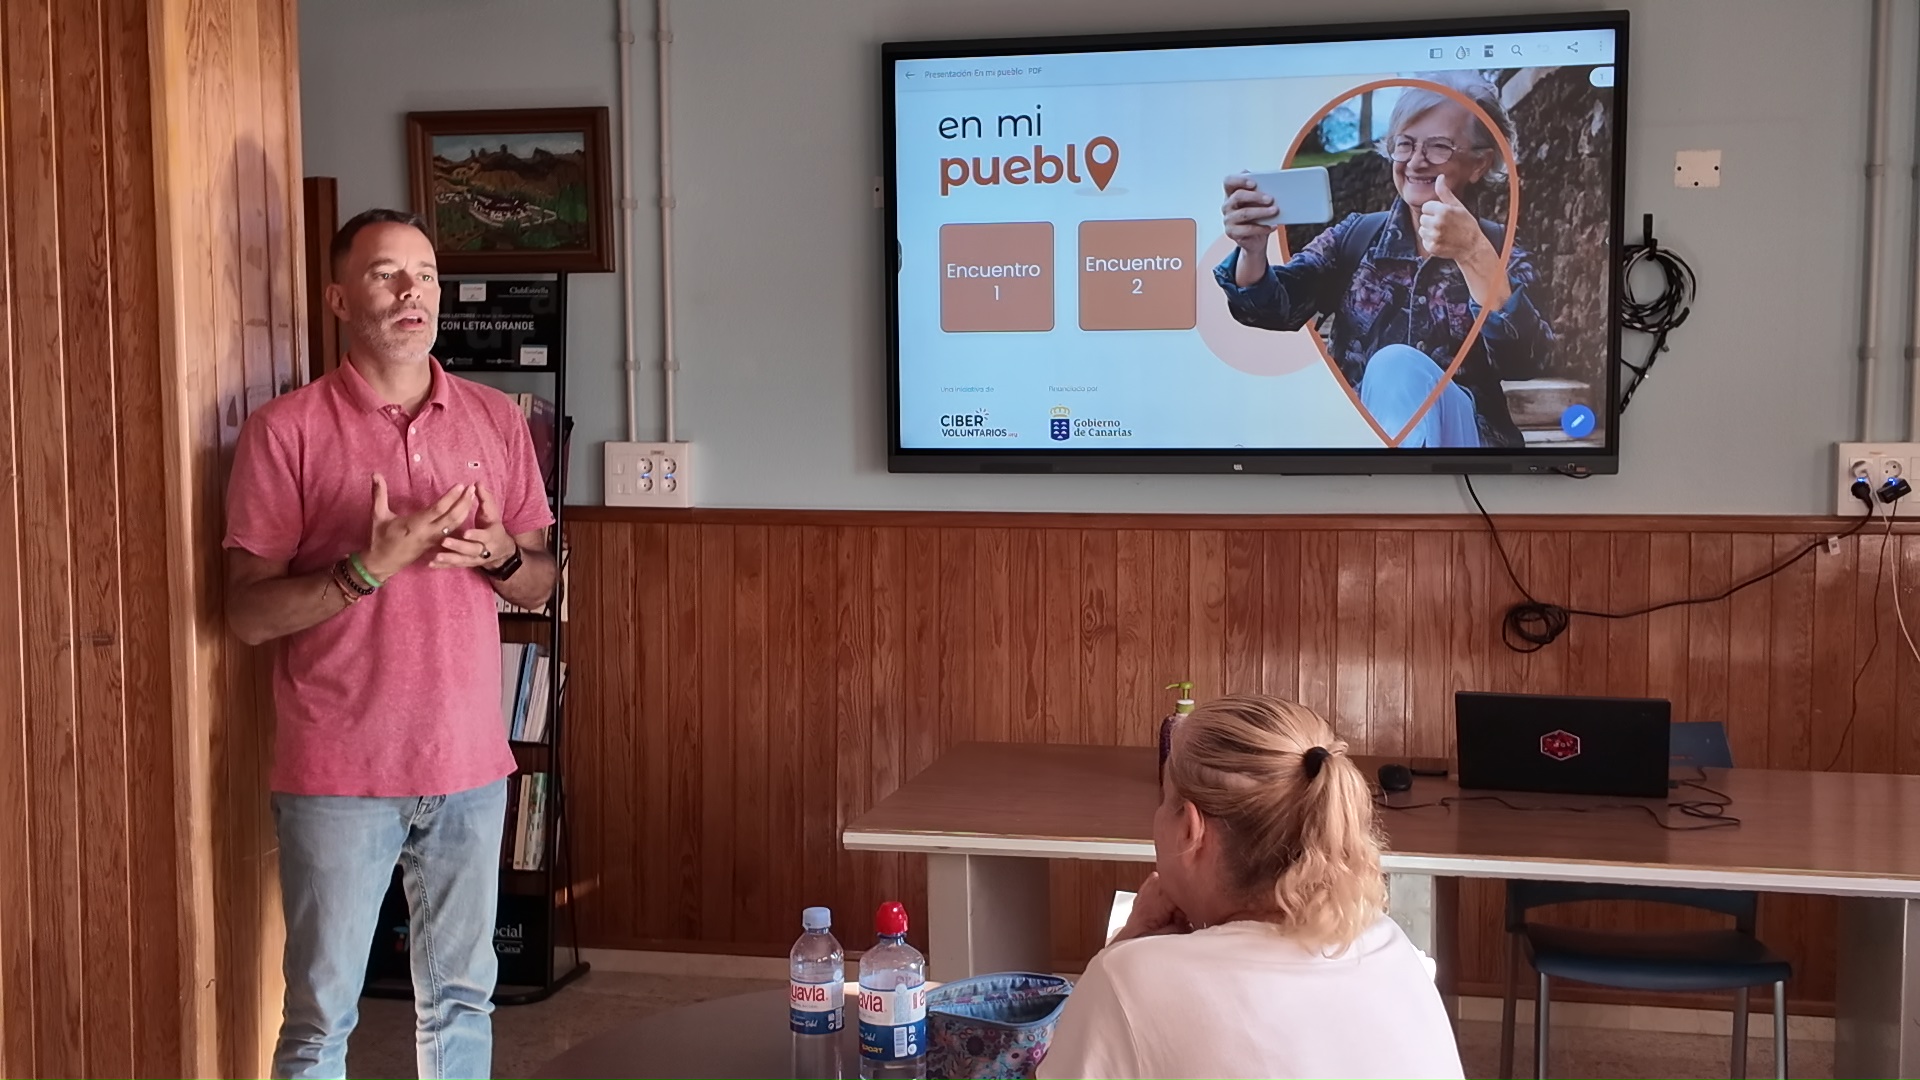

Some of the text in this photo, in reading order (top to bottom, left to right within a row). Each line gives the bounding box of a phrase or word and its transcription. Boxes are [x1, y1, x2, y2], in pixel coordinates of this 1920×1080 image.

[1028, 67, 1042, 75] PDF
[938, 103, 1043, 140] en mi
[946, 262, 1041, 279] Encuentro
[1085, 256, 1182, 273] Encuentro
[993, 285, 1000, 301] 1
[1131, 278, 1144, 295] 2
[440, 321, 535, 331] CON LETRA GRANDE
[940, 414, 984, 427] CIBER
[1073, 418, 1121, 428] Gobierno
[1073, 428, 1133, 438] de Canarias
[494, 923, 522, 937] ocial
[791, 984, 826, 1003] uavia
